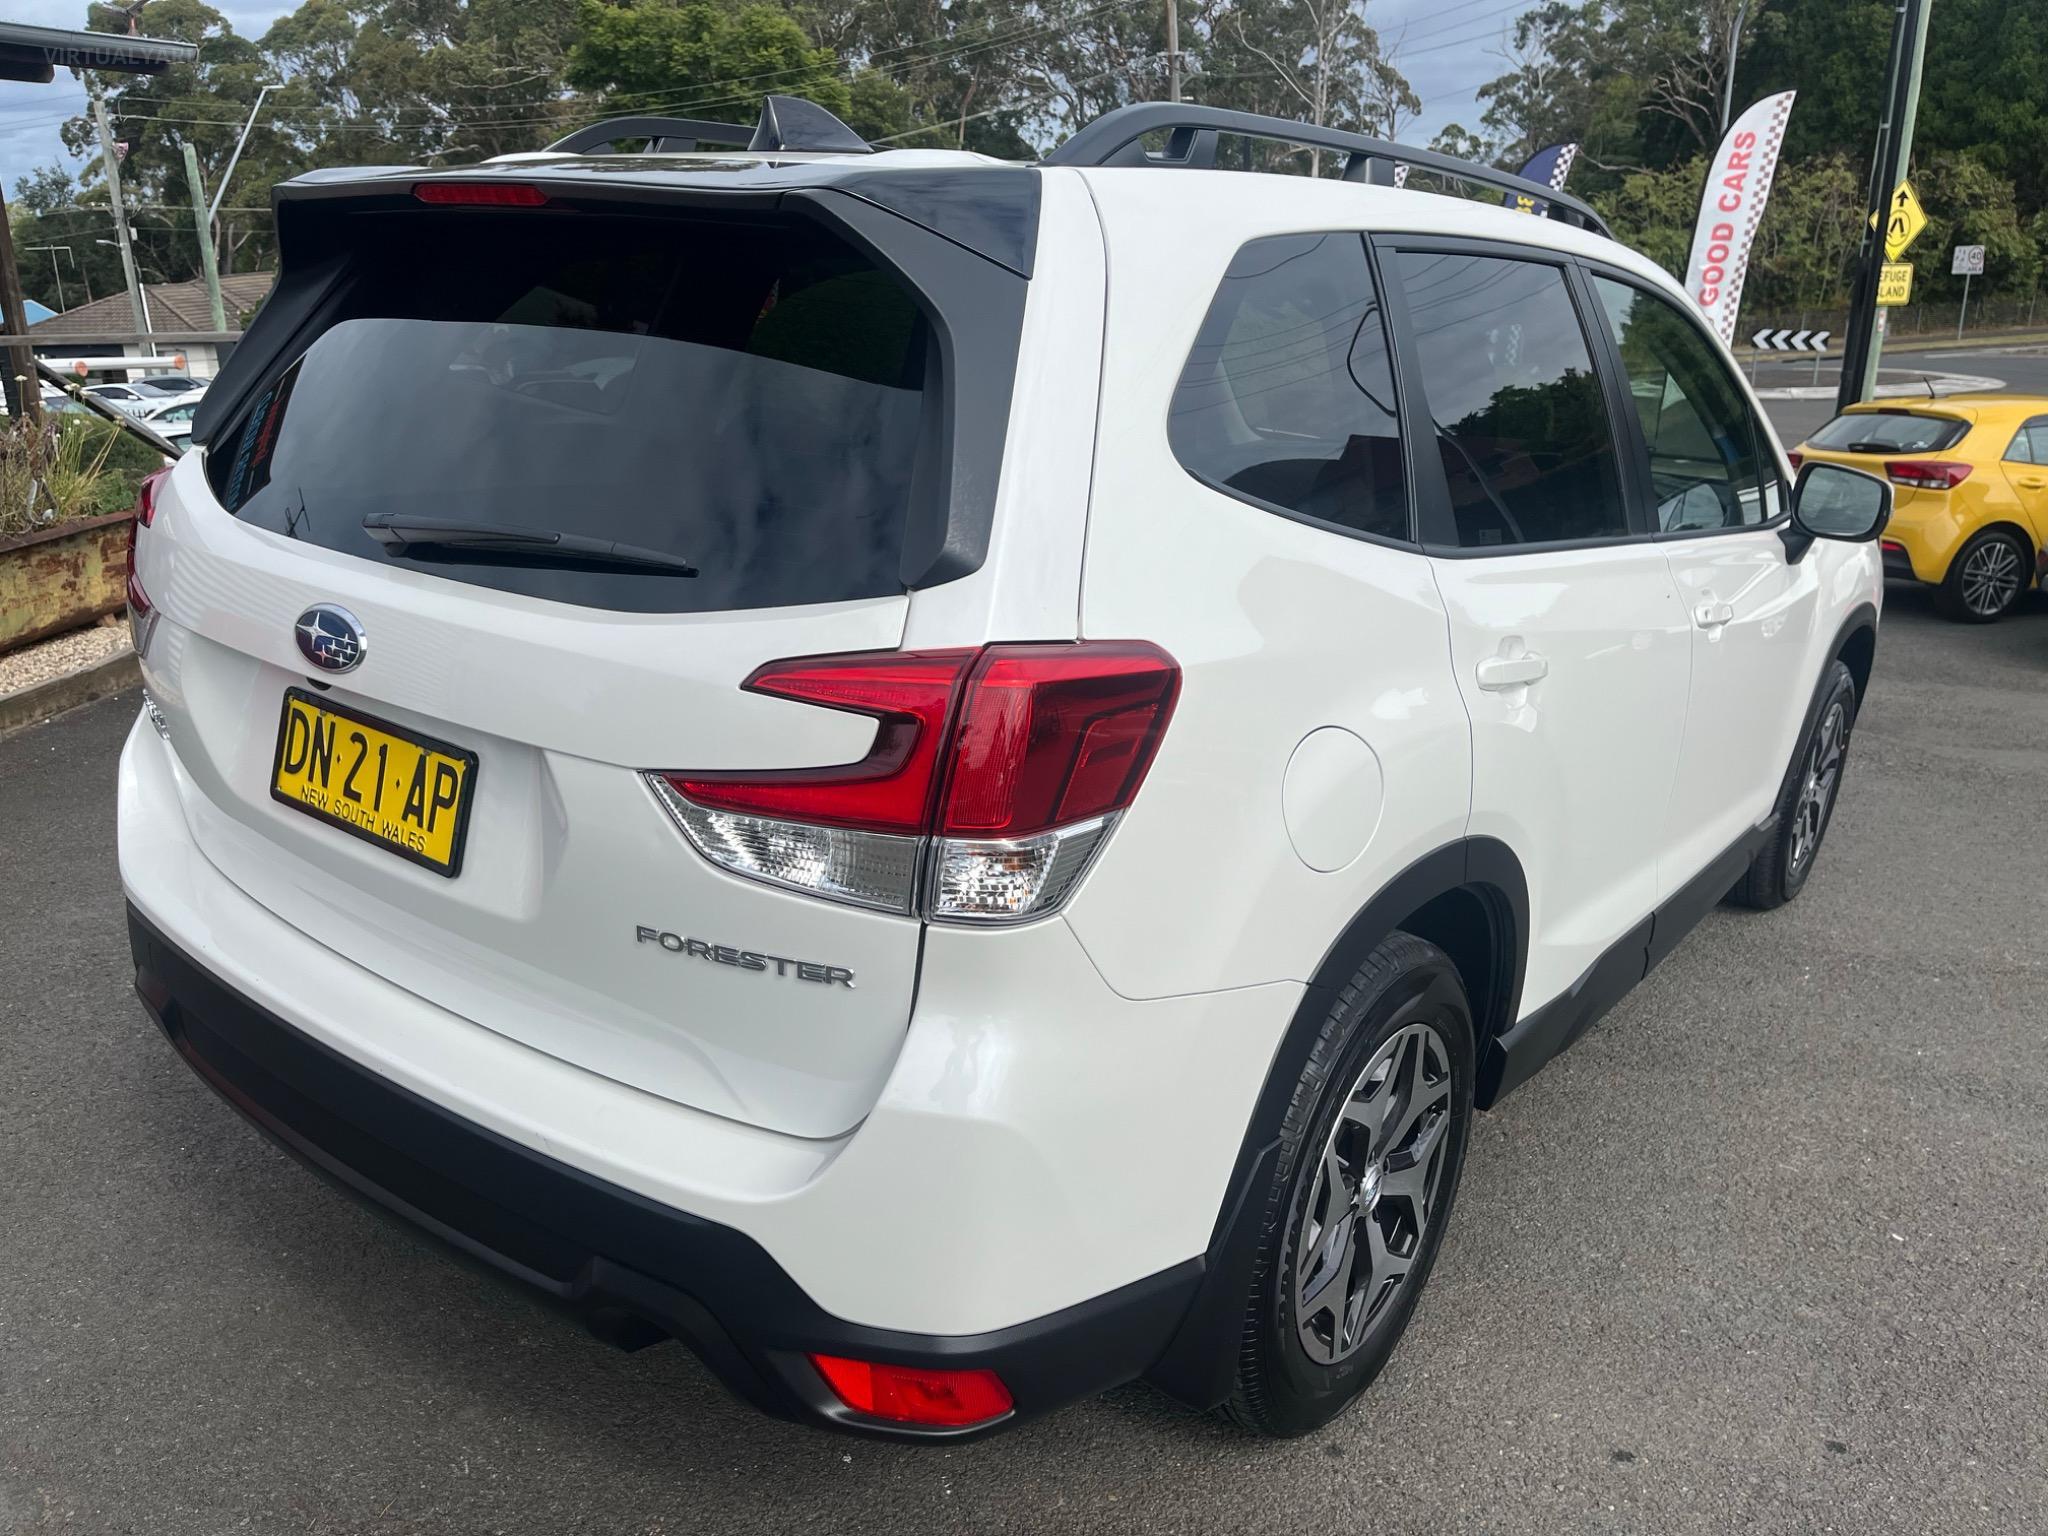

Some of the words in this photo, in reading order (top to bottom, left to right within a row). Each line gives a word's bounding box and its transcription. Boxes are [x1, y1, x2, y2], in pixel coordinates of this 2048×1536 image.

[1698, 223, 1734, 306] GOOD
[1718, 131, 1756, 212] CARS
[1880, 270, 1908, 282] EFUGE
[302, 787, 329, 811] NEW
[333, 800, 376, 830] SOUTH
[382, 819, 427, 852] WALES
[635, 925, 856, 989] FORESTER
